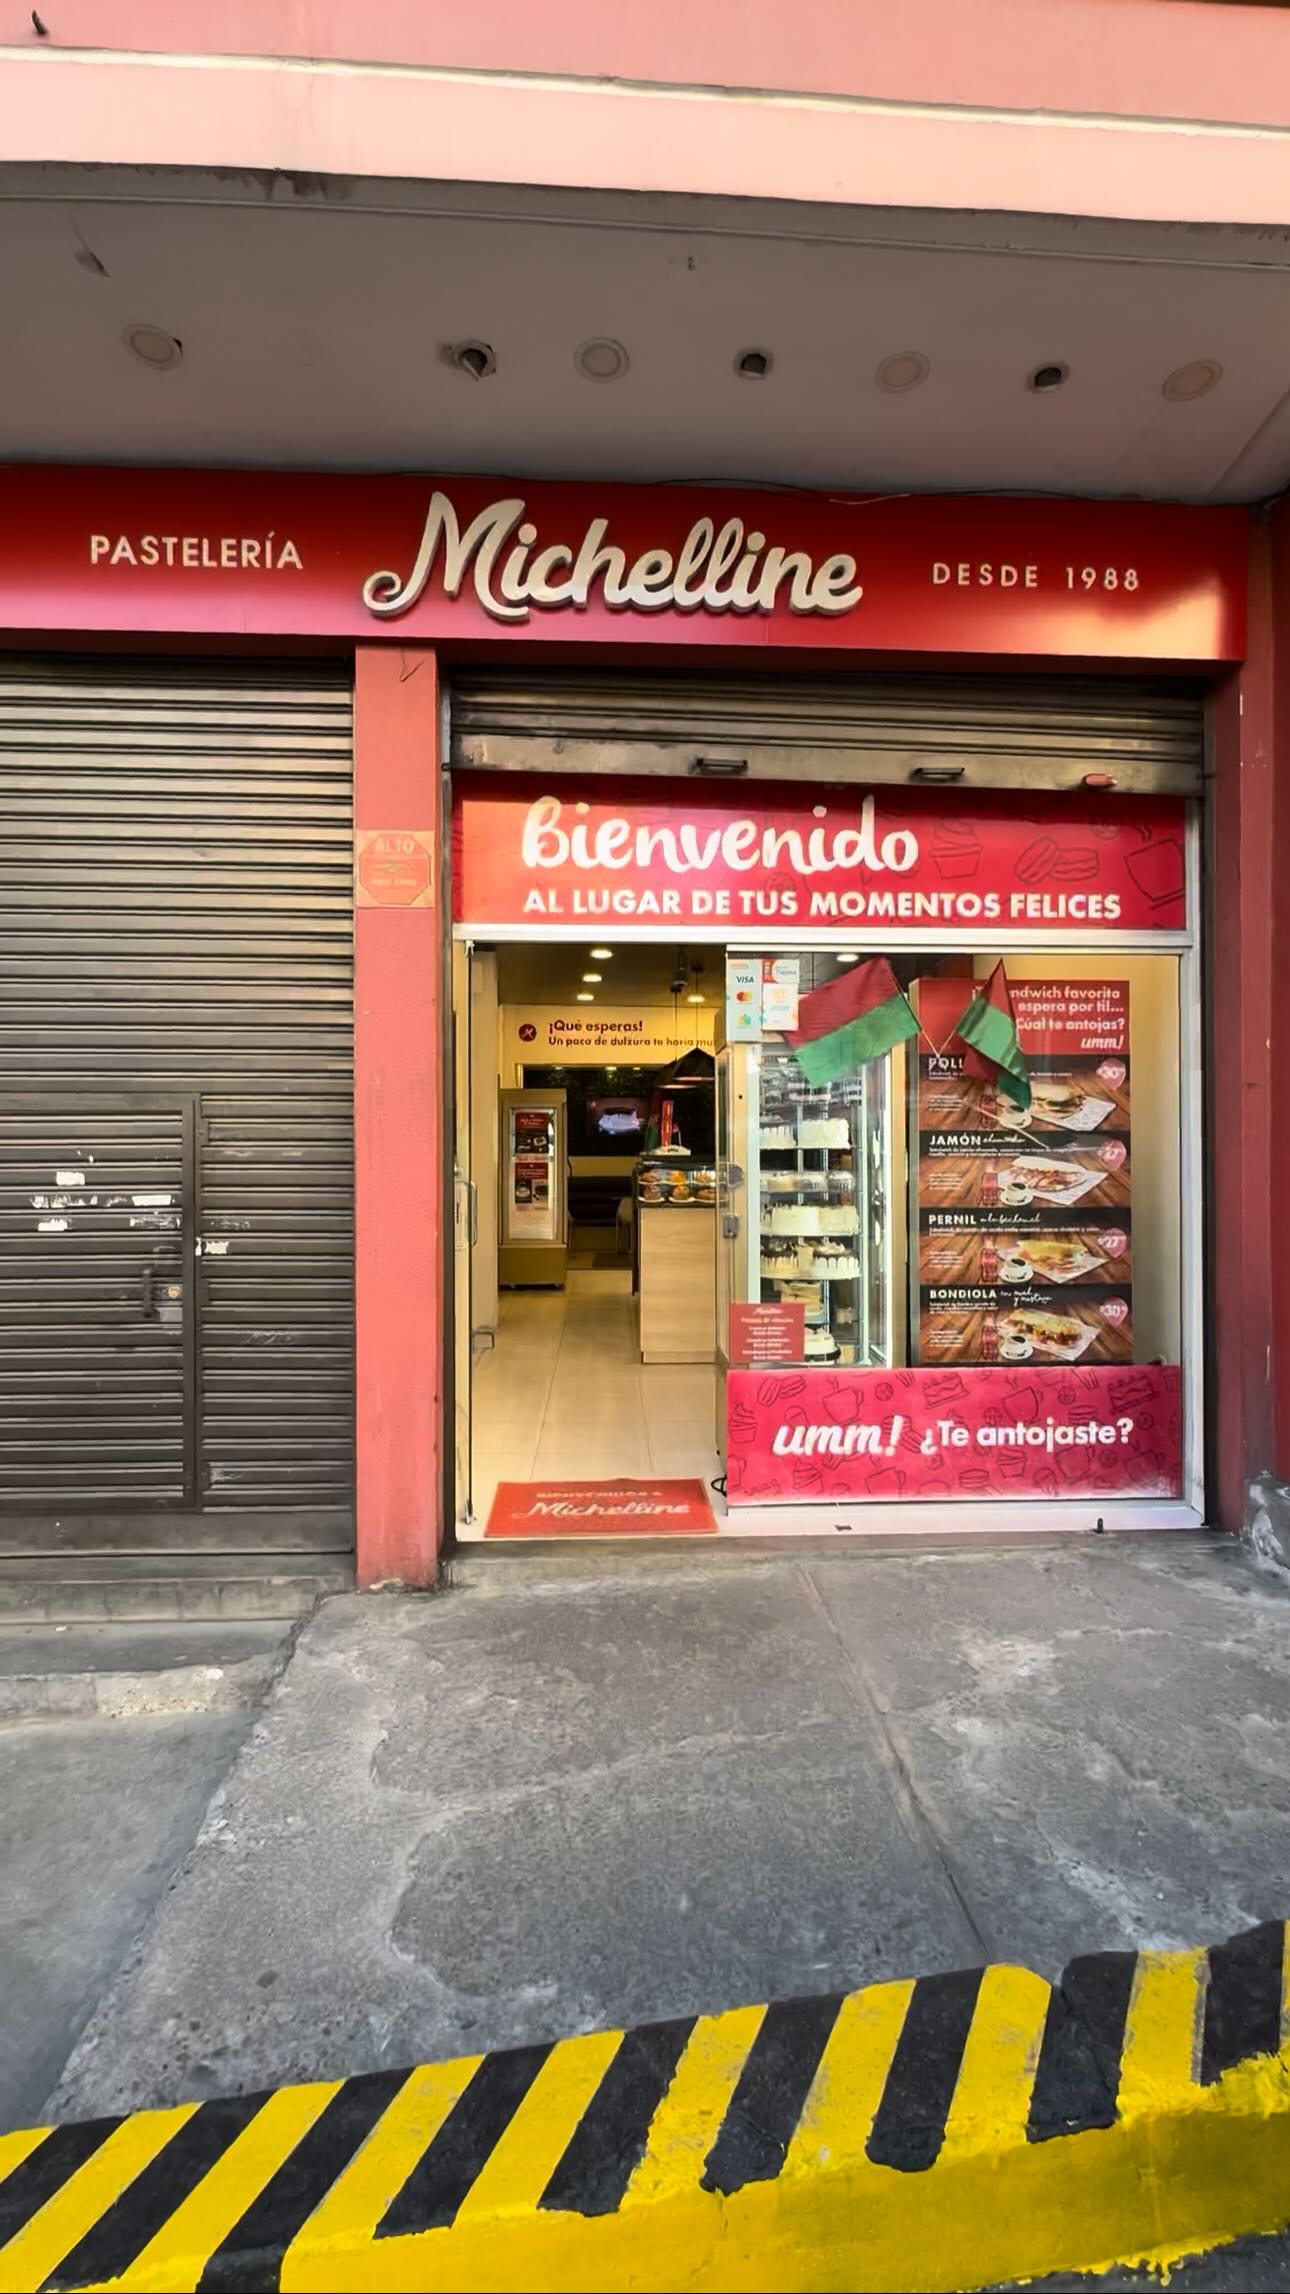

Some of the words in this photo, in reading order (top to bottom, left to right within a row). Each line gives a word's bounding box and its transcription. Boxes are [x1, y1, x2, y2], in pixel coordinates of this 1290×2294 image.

[90, 532, 303, 570] PASTELERÍA
[363, 491, 864, 622] Michelline
[933, 562, 1038, 588] DESDE
[1065, 567, 1138, 591] 1988
[522, 794, 919, 875] bienvenido
[376, 837, 415, 854] ALTO
[523, 889, 563, 912] AL
[573, 889, 681, 914] LUGAR
[692, 890, 729, 914] DE
[739, 890, 798, 915] TUS
[809, 892, 1000, 918] MOMENTOS
[1010, 893, 1121, 919] FELICES
[1010, 986, 1061, 998] ndwich
[1018, 1003, 1066, 1015] espera
[1069, 1003, 1094, 1016] por
[548, 1019, 582, 1034] ¡Qué
[585, 1020, 643, 1034] esperas!
[1049, 1019, 1063, 1031] te
[1066, 1017, 1125, 1033] antojas?
[548, 1036, 564, 1045] Un
[565, 1039, 591, 1047] poco
[594, 1036, 607, 1045] de
[610, 1036, 651, 1046] dulzura
[653, 1038, 663, 1046] te
[1081, 1034, 1124, 1050] umm!
[930, 1132, 981, 1146] JAMÓN
[929, 1214, 977, 1225] PERNIL
[929, 1289, 997, 1299] BONDIOLA
[772, 1415, 903, 1456] umm!
[920, 1420, 969, 1455] ¿Te
[977, 1417, 1134, 1453] antojaste?
[512, 1502, 690, 1518] Michelline
